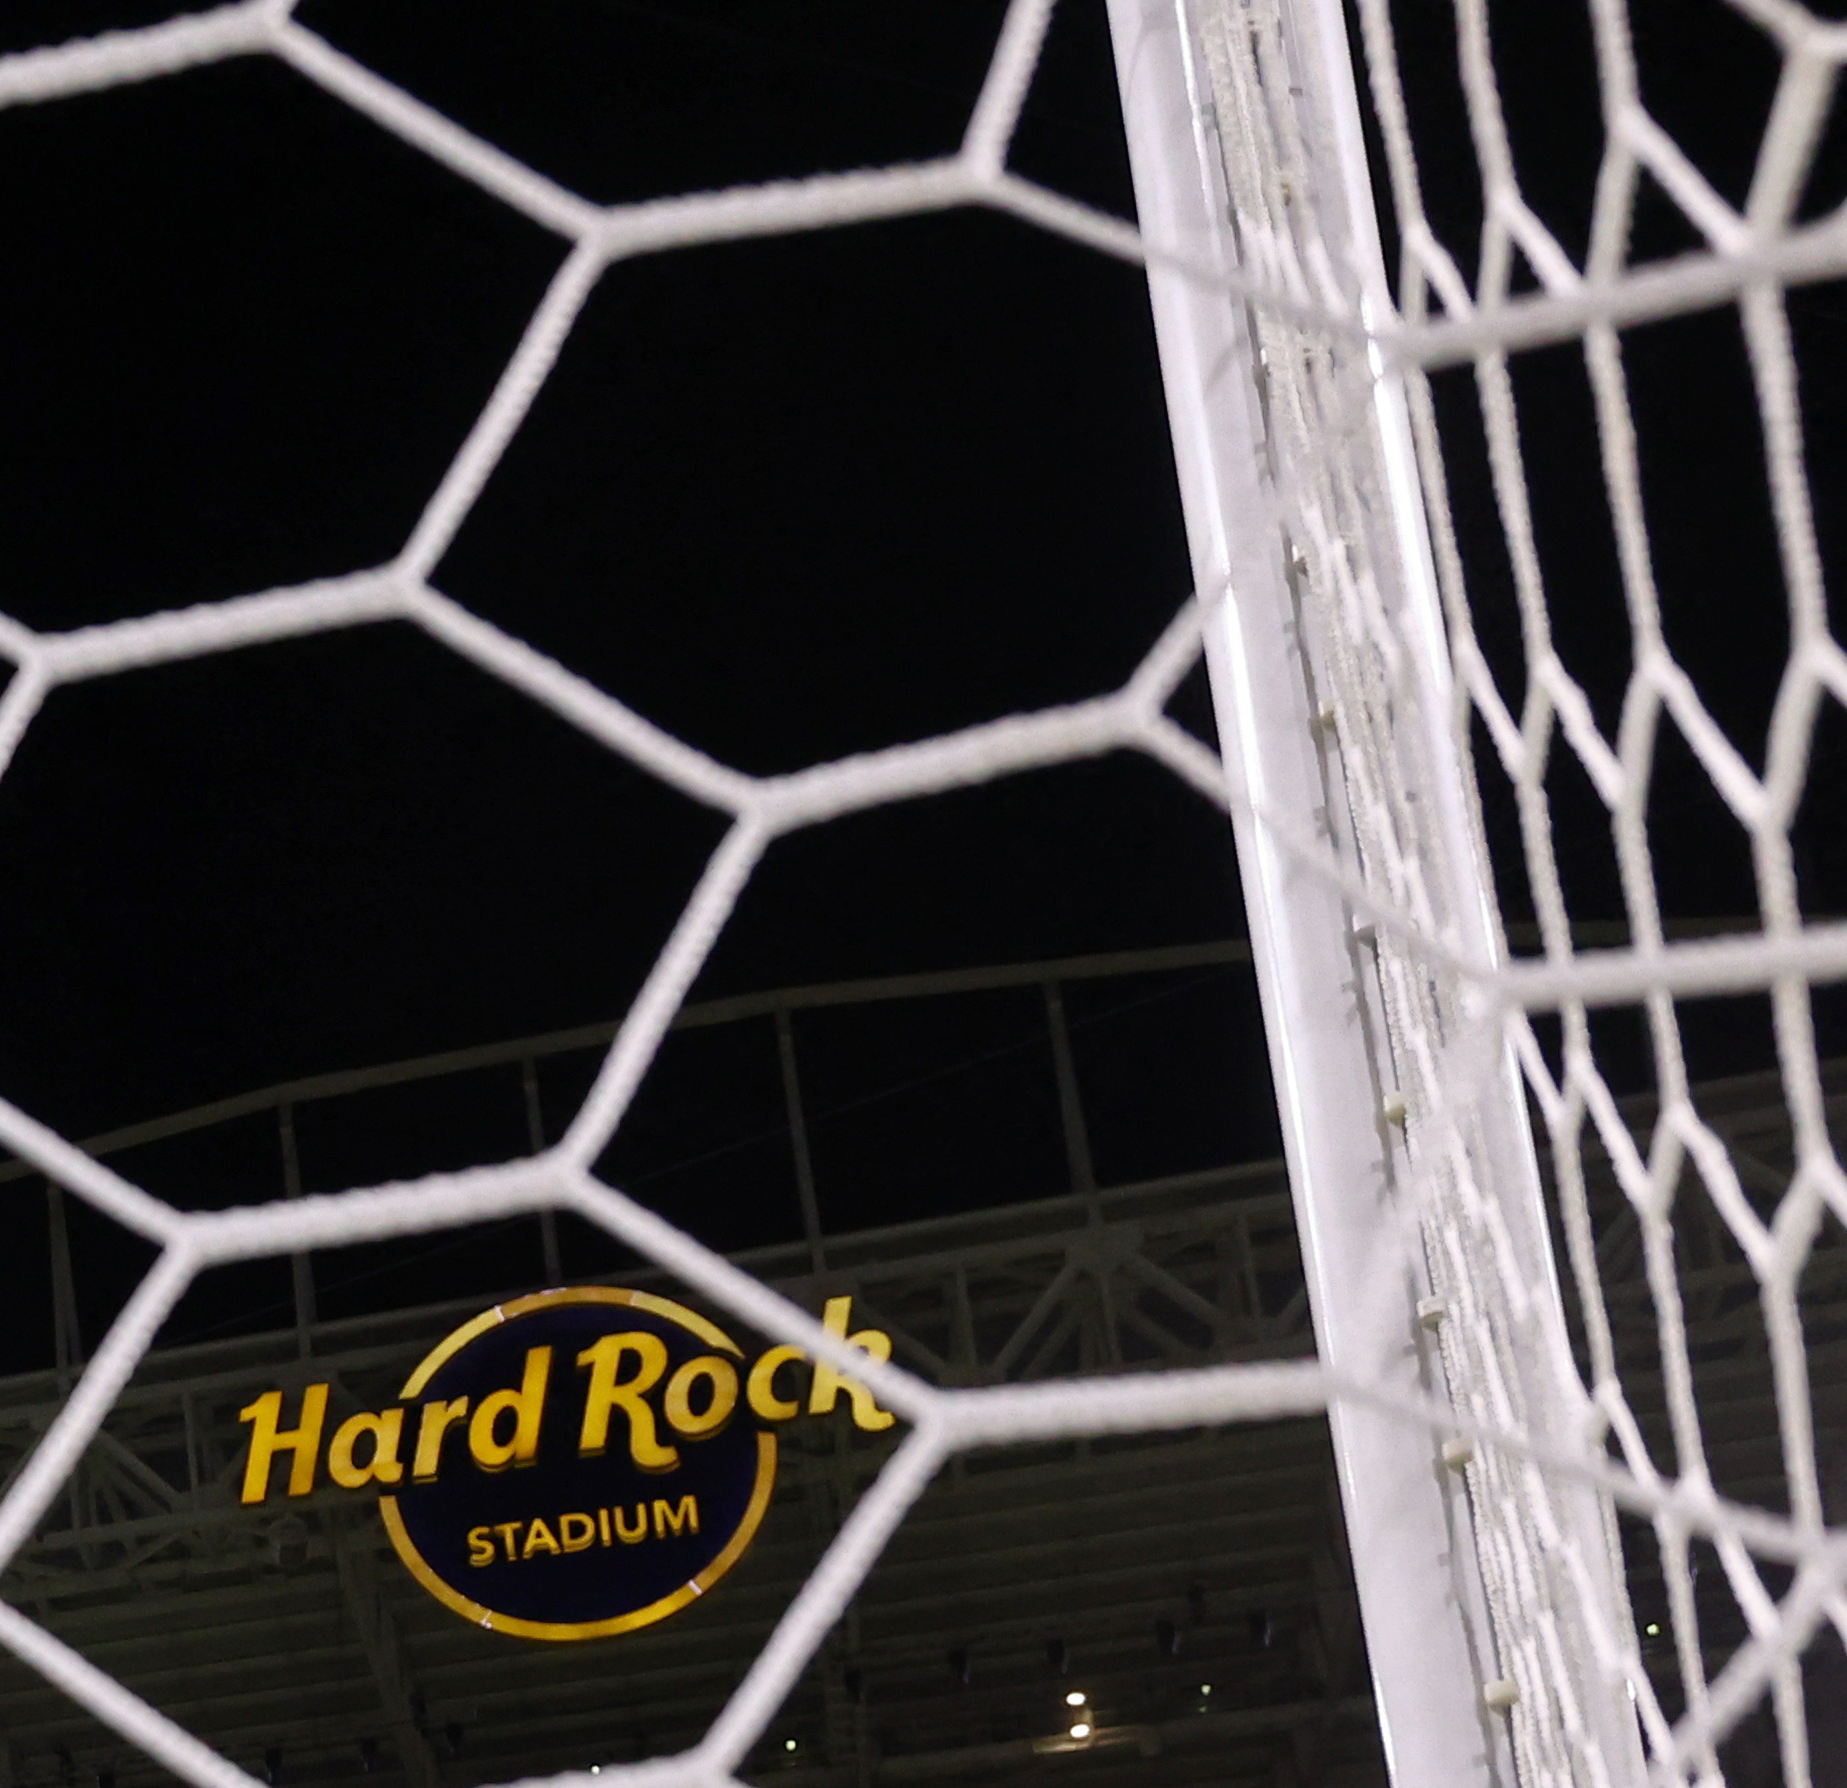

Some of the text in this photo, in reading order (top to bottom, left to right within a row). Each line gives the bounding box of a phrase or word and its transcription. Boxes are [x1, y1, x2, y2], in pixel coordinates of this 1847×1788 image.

[238, 1296, 895, 1504] Hard Rock
[466, 1496, 700, 1566] STADIUM
